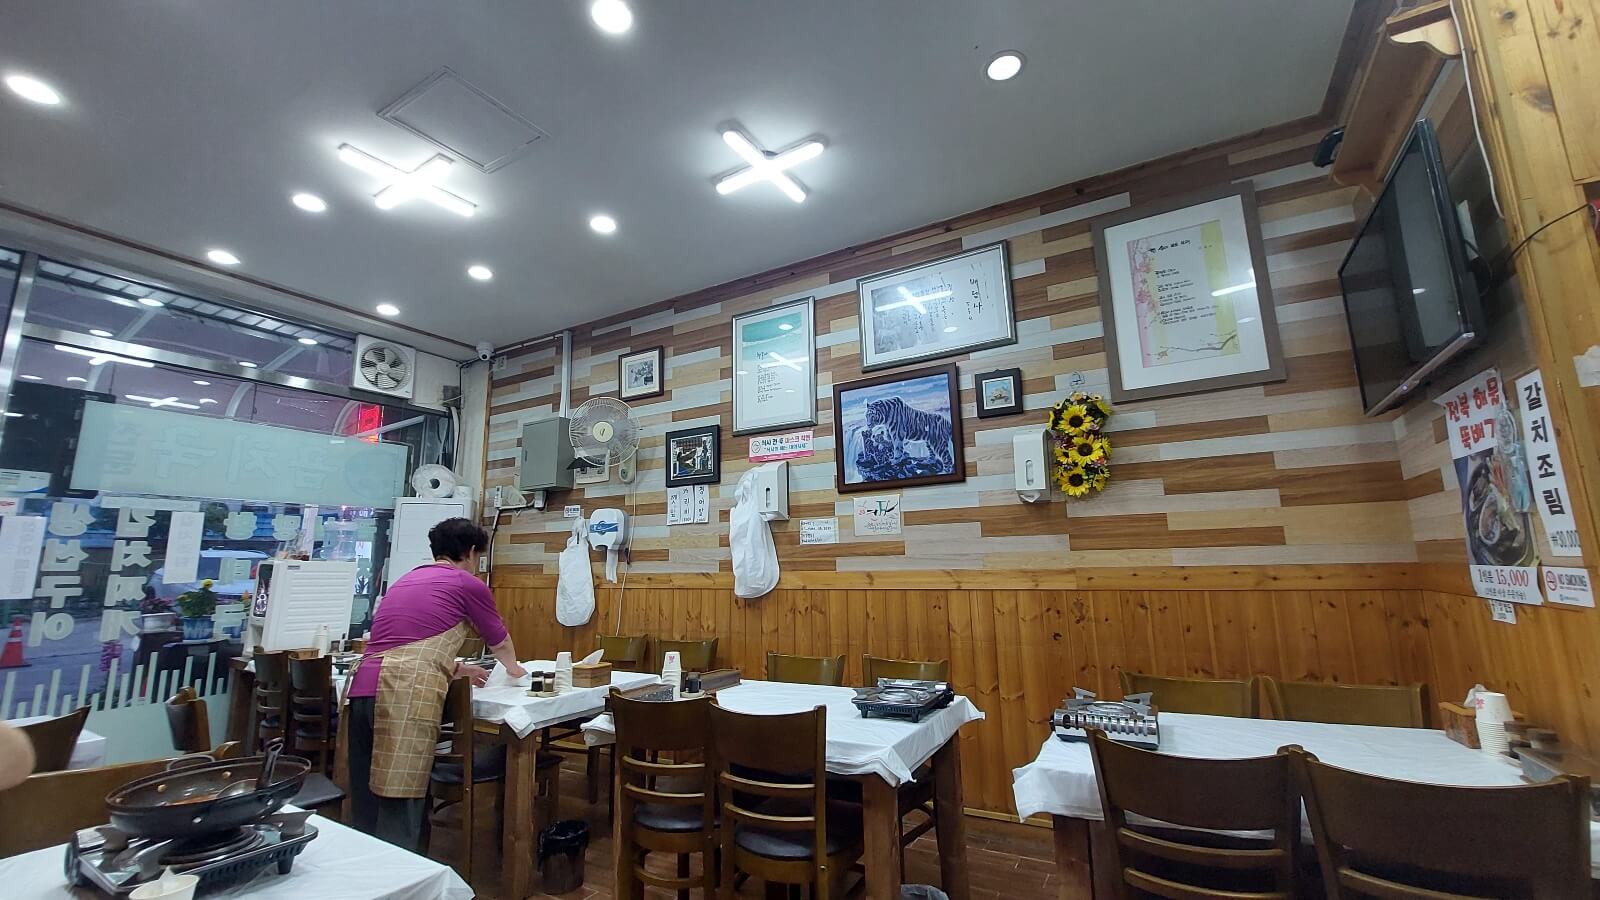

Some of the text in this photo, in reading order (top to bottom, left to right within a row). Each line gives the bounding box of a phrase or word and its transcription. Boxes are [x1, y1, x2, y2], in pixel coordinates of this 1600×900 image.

[1445, 377, 1500, 422] 전복 해물
[785, 435, 800, 443] 마스크
[1523, 381, 1566, 516] 갈치조림
[1495, 569, 1529, 587] 15,000
[1557, 573, 1588, 587] NO SMOKING
